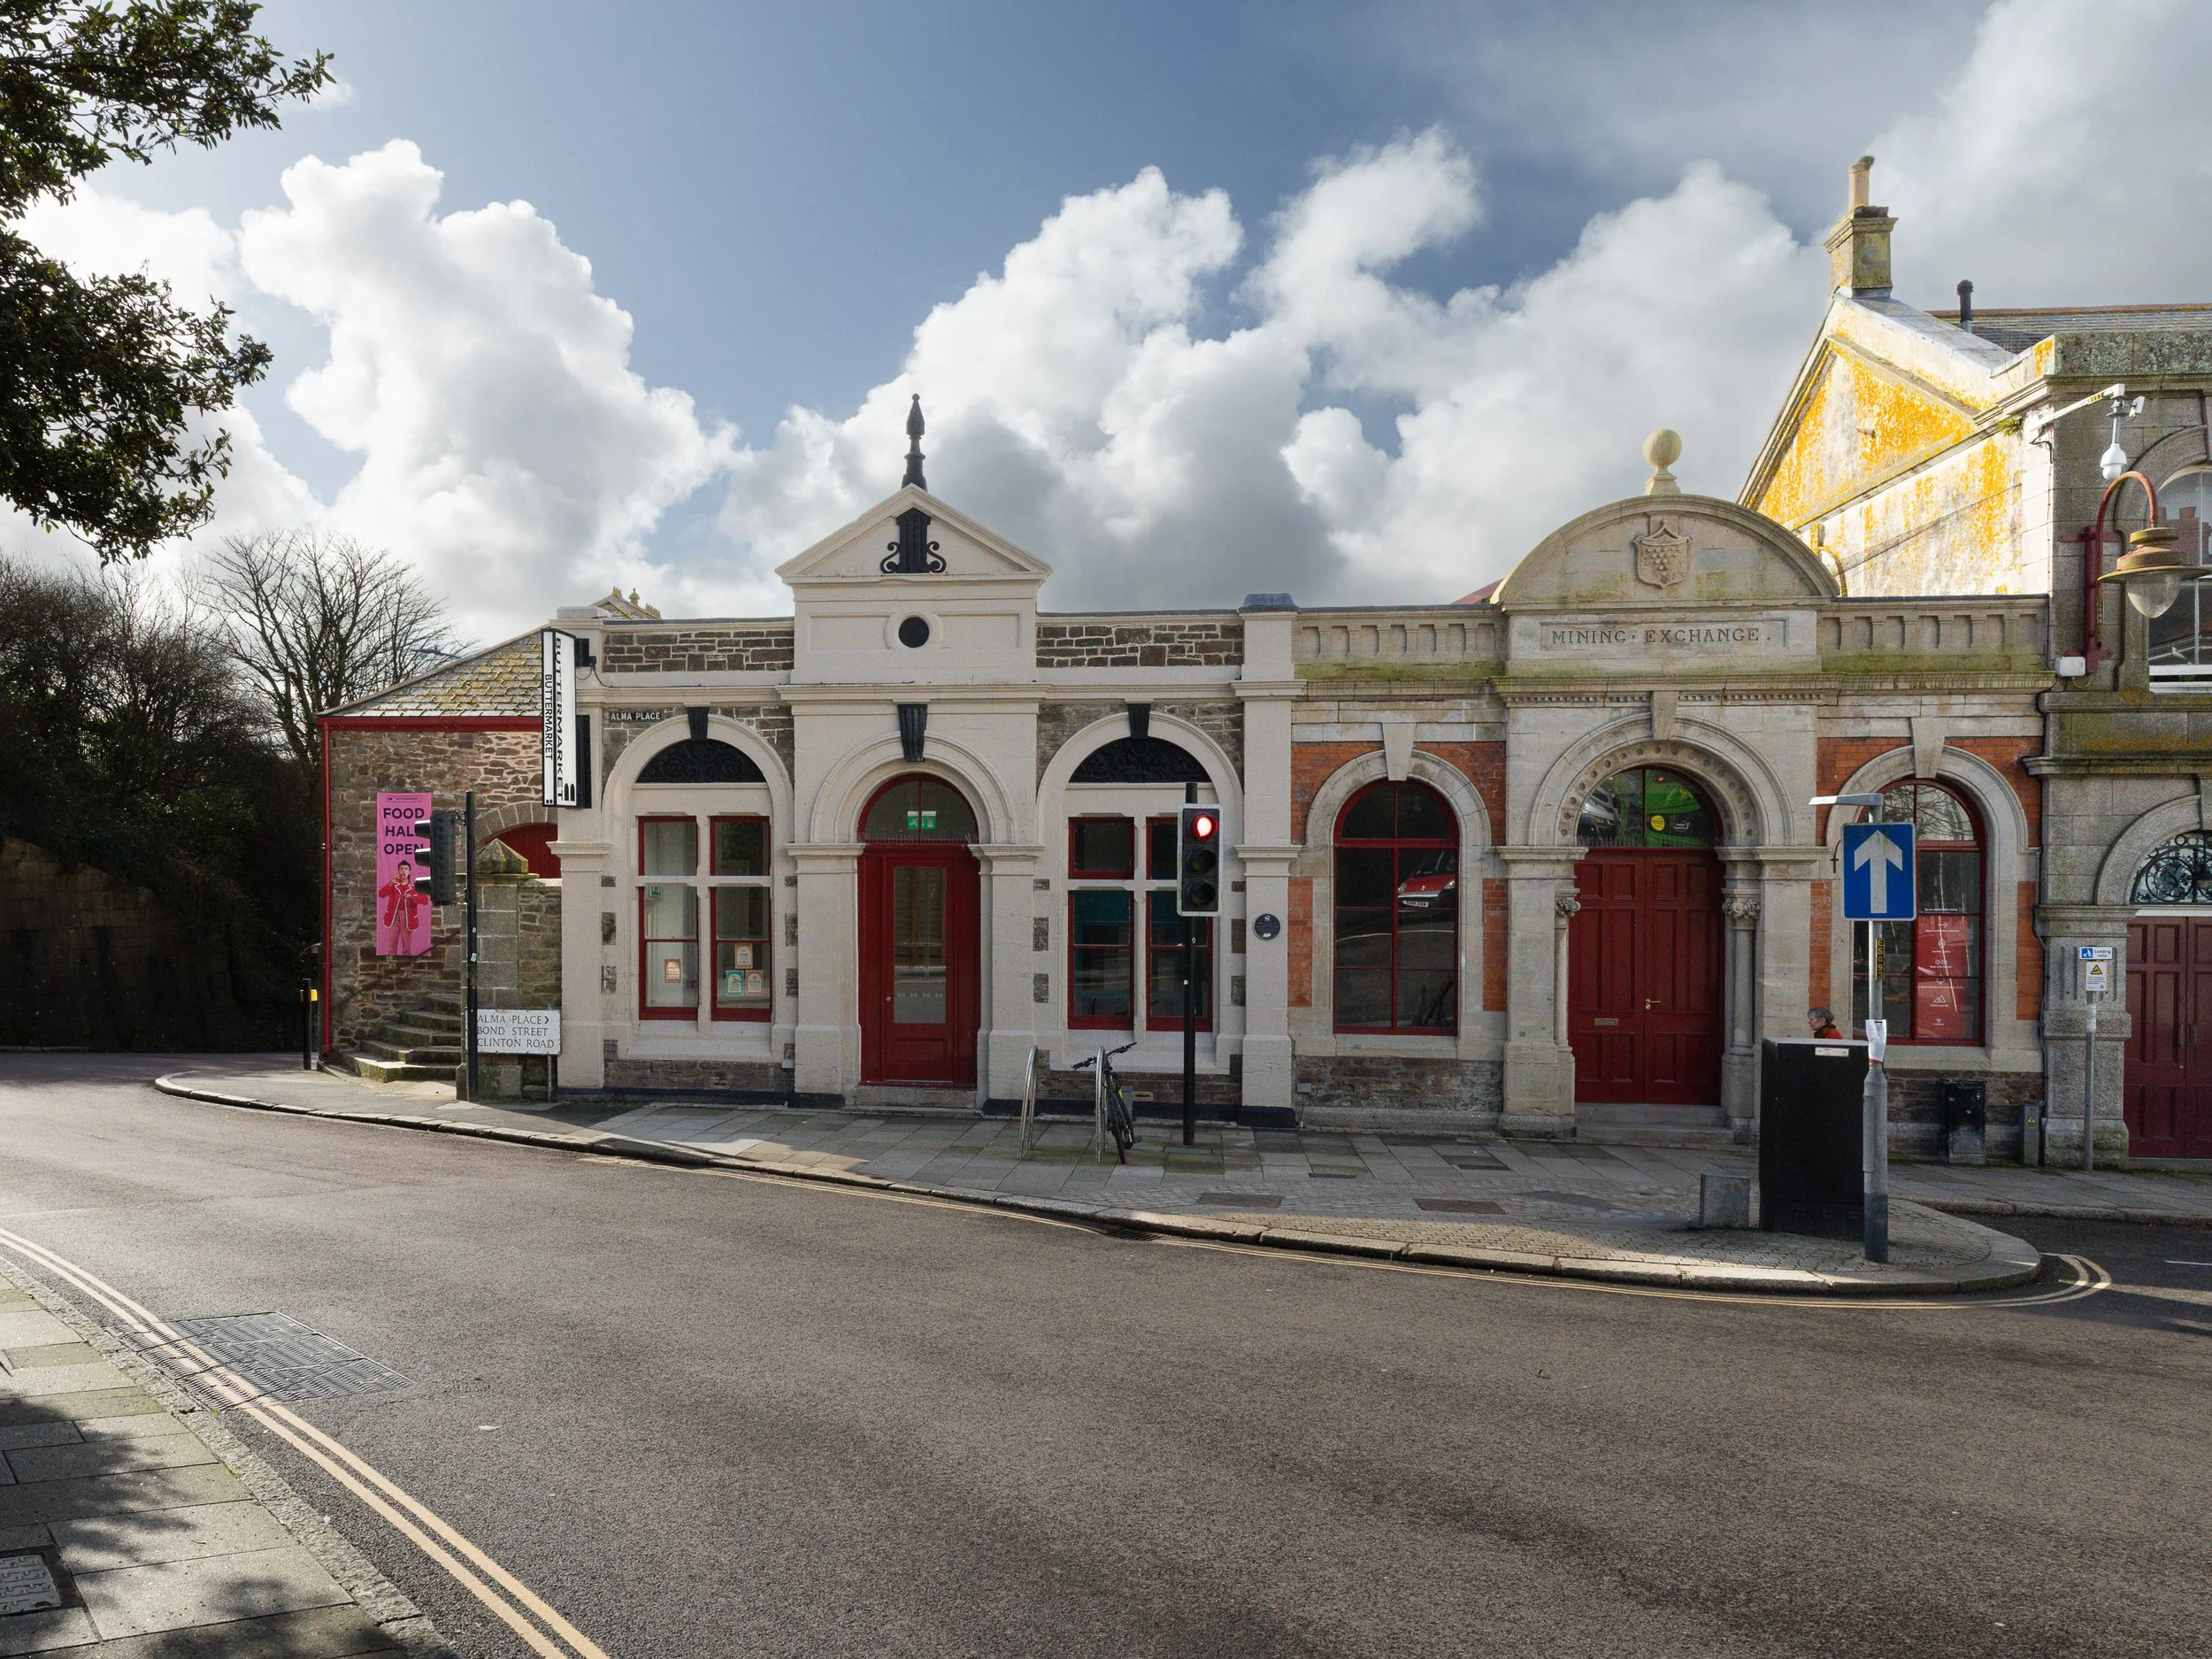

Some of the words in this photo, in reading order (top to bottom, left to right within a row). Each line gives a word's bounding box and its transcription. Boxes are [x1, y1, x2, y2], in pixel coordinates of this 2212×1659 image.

[1552, 630, 1626, 644] MINING
[1644, 628, 1759, 643] EXCHANGE
[544, 674, 553, 760] BUTTERMARKET
[635, 711, 661, 720] PLACE
[383, 808, 425, 819] FOOD
[385, 826, 418, 837] HAL
[478, 1015, 506, 1024] ALMA
[511, 1015, 542, 1025] PLACE
[478, 1026, 505, 1035] BOND
[511, 1026, 549, 1036] STREET
[478, 1038, 521, 1047] CLINTON
[526, 1039, 555, 1048] ROAD
